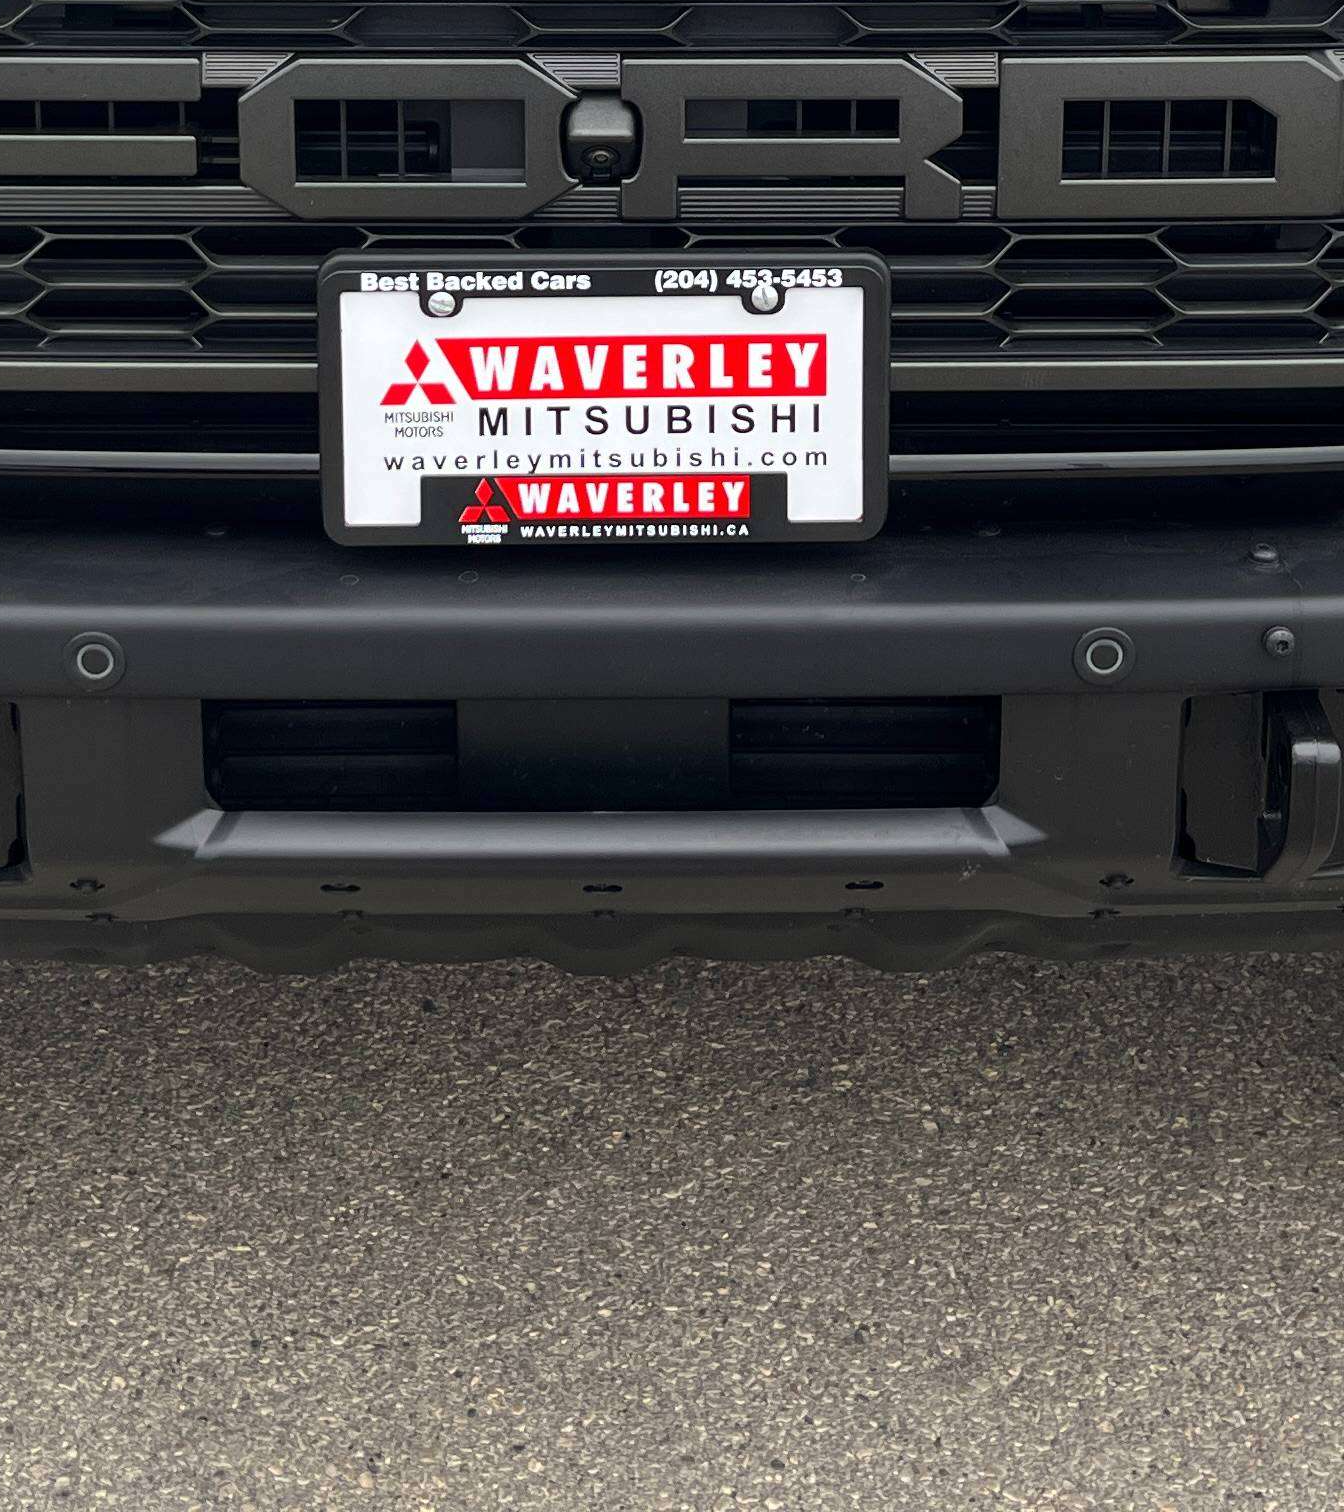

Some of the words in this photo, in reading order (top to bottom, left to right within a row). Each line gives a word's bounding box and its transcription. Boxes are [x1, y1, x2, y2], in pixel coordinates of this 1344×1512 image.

[360, 272, 419, 292] Best
[426, 271, 523, 291] Backed
[531, 270, 592, 290] Cars
[655, 269, 718, 293] (204)
[726, 268, 843, 288] 453-5453
[469, 342, 820, 392] WAVERLEY
[384, 411, 454, 423] MITSUBISHI
[479, 403, 820, 436] MITSUBISHI
[394, 426, 444, 438] MOTORS
[384, 447, 827, 474] waverleymitsubishi.com
[517, 481, 745, 514] WAVERLEY
[461, 524, 509, 534] MITSUBISHI
[520, 524, 749, 538] WAVERLEYMITSUBISHI.CA
[467, 534, 501, 544] MOTORS
